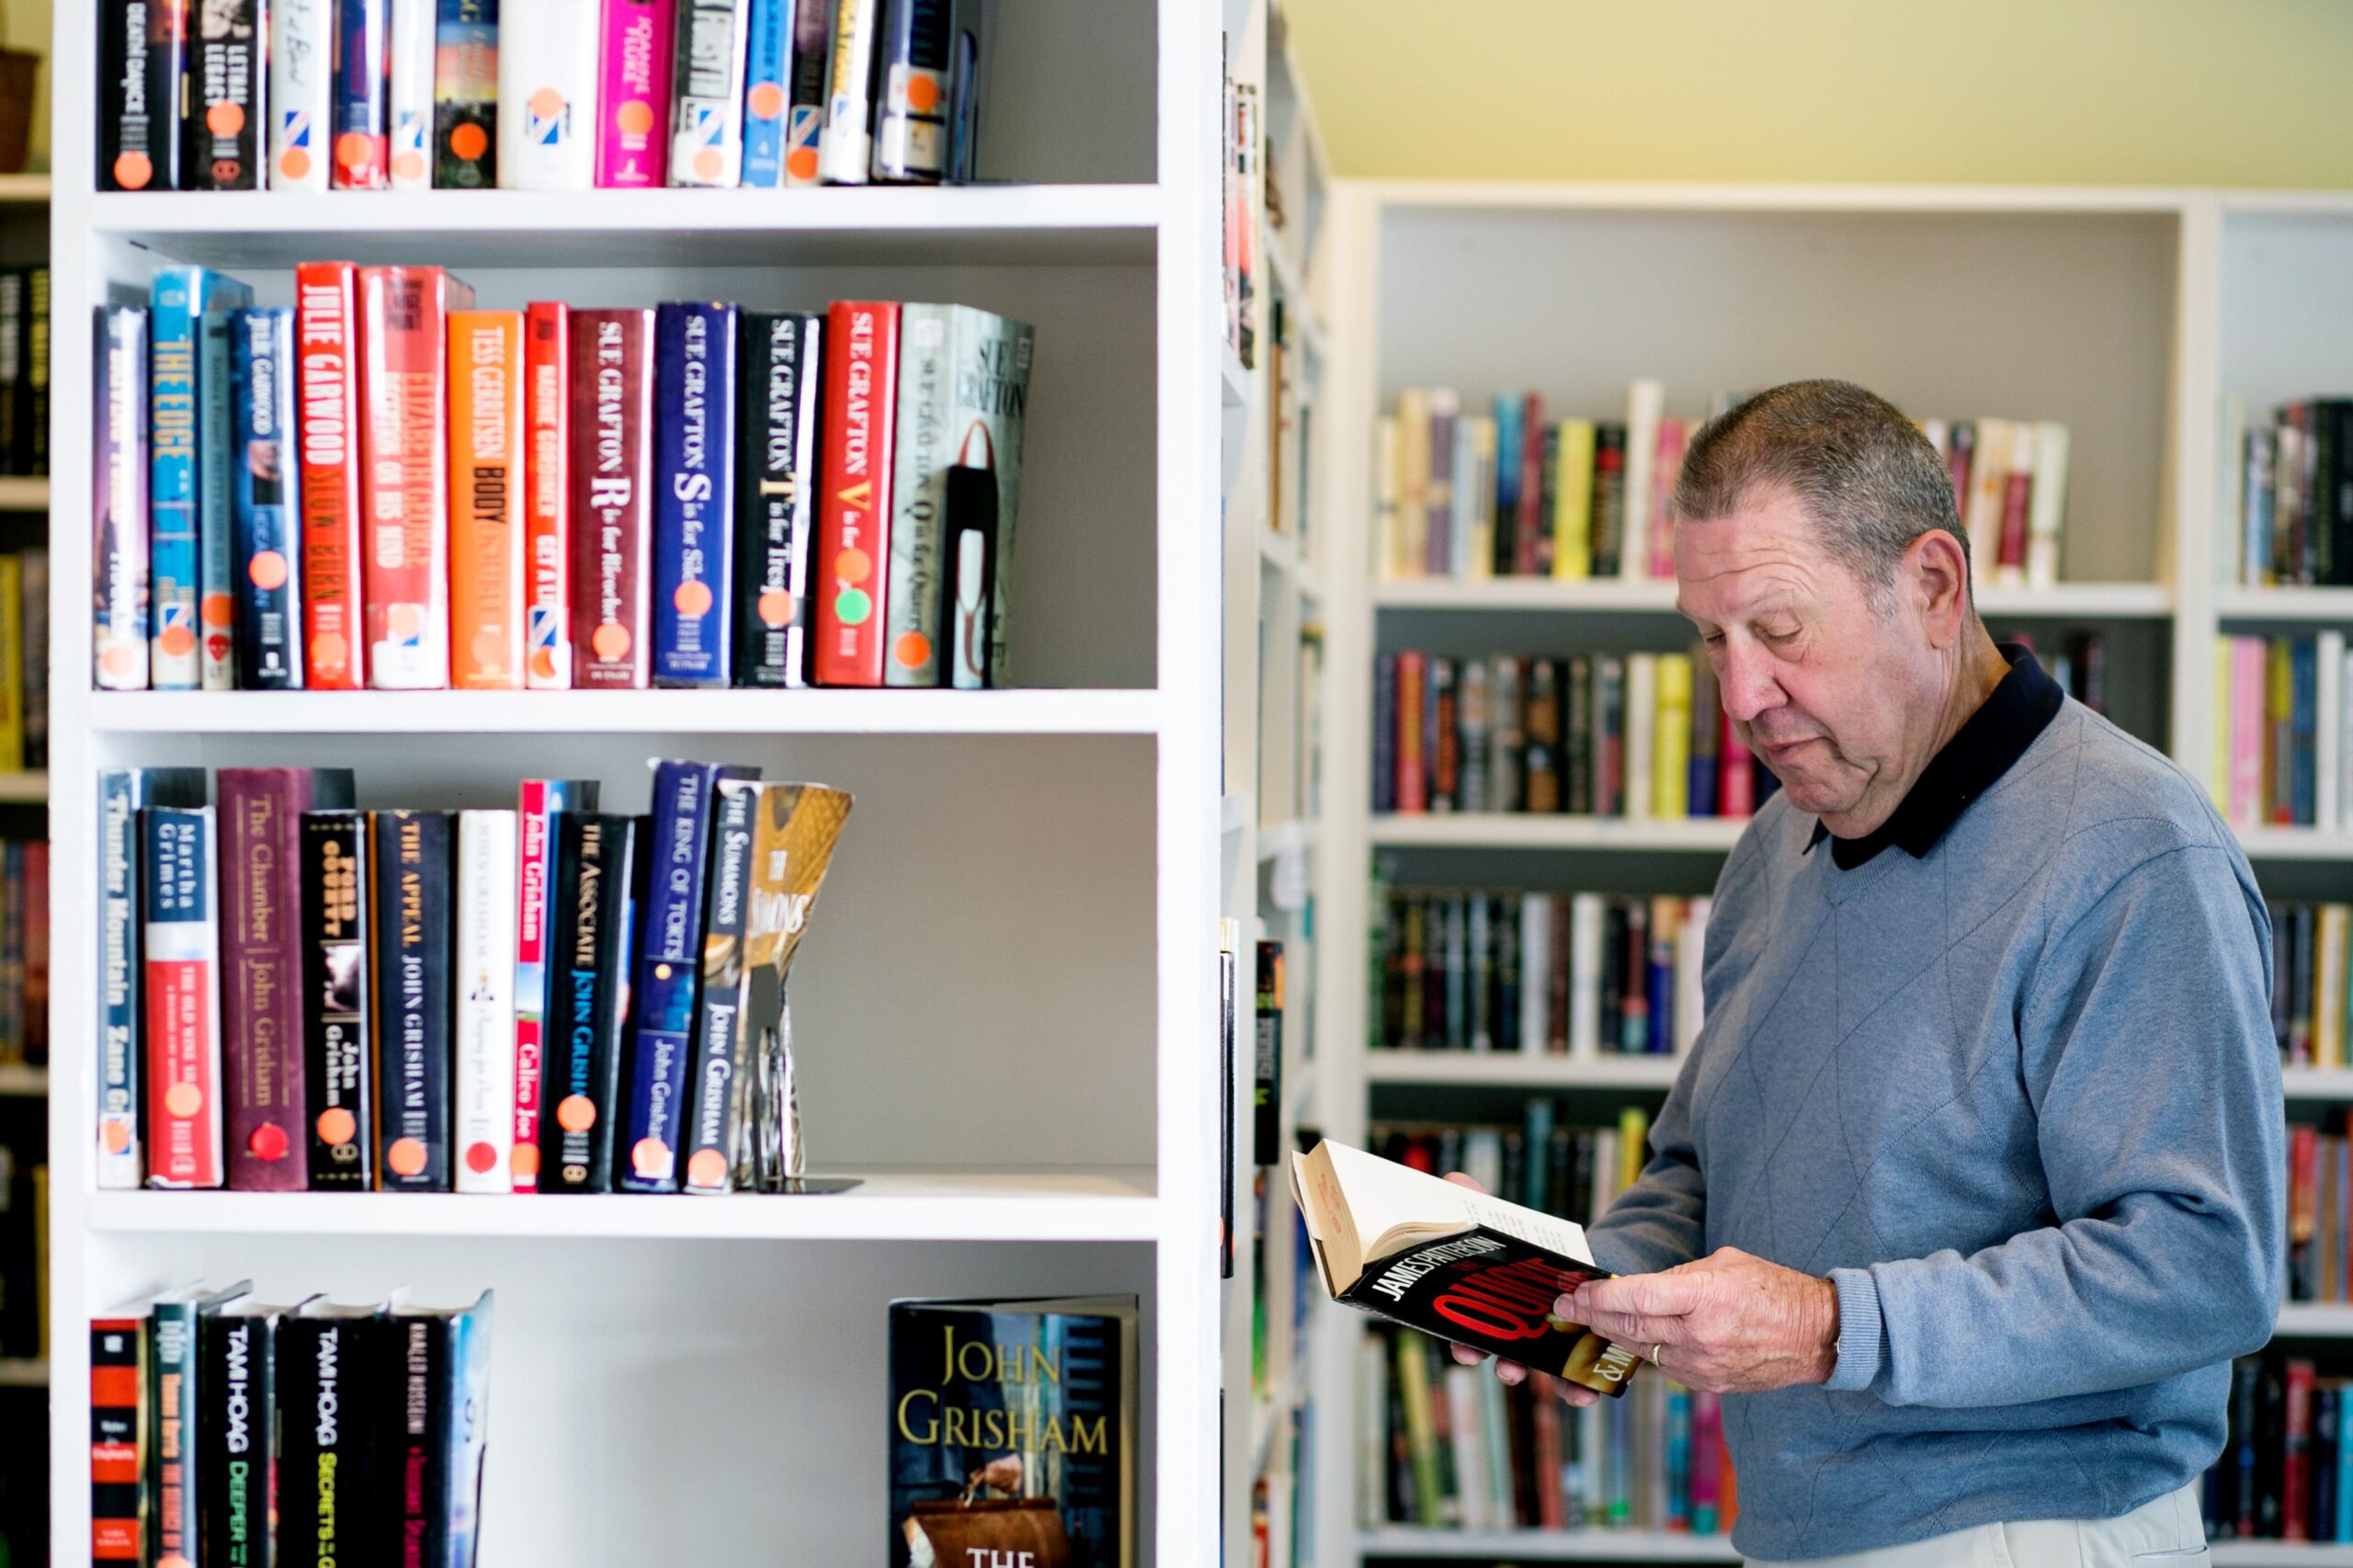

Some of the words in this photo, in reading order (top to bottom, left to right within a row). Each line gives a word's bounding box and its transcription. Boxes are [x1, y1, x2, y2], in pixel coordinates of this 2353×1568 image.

[634, 16, 652, 95] JOANNE
[247, 316, 272, 357] JULIE
[303, 286, 344, 346] JULIE
[685, 315, 706, 359] SUE
[771, 320, 796, 363] SUE
[850, 312, 872, 358] SUE
[153, 338, 193, 387] THE
[472, 326, 505, 364] TESS
[598, 322, 623, 365] SUE
[252, 358, 273, 436] GARWOOD
[304, 354, 346, 465] GARWOOD
[472, 367, 505, 459] GERRITSEN
[535, 364, 557, 427] NADINE
[598, 369, 624, 472] GRAFTON
[684, 361, 706, 469] GRAFTON
[769, 364, 795, 471] GRAFTON
[845, 360, 872, 474] GRAFTON
[153, 393, 193, 461] EDGE
[404, 371, 435, 478] ELIZABETH
[307, 471, 344, 528] SLOW
[375, 461, 404, 485] ON
[473, 466, 506, 526] BODY
[535, 430, 557, 517] GORDIMER
[592, 476, 632, 509] R
[675, 472, 711, 501] S
[760, 472, 798, 505] T
[837, 480, 871, 511] V
[375, 490, 404, 519] HIS
[403, 487, 434, 569] GEORGE
[603, 509, 621, 525] is
[683, 502, 703, 518] is
[768, 518, 791, 542] for
[769, 503, 788, 517] is
[843, 512, 859, 526] is
[904, 501, 934, 522] Q
[375, 526, 404, 569] MIND
[536, 535, 557, 566] GET
[602, 526, 625, 552] for
[682, 519, 704, 547] for
[842, 526, 860, 549] for
[308, 543, 345, 600] BURN
[536, 569, 557, 583] A
[602, 553, 625, 624] Ricochet
[249, 795, 272, 836] The
[679, 775, 699, 813] THE
[726, 792, 747, 826] THE
[107, 794, 130, 892] Thunder
[402, 822, 421, 863] THE
[477, 824, 489, 869] JOHN
[524, 812, 543, 858] John
[582, 824, 601, 858] THE
[673, 818, 695, 864] KING
[159, 823, 178, 908] Grimes
[178, 824, 197, 909] Martha
[324, 839, 341, 937] COUNTY
[340, 856, 357, 922] FORD
[671, 870, 691, 895] OF
[718, 830, 750, 926] SUMMONS
[251, 844, 276, 943] Chamber
[402, 870, 421, 949] APPEAL
[523, 860, 543, 941] Grisham
[575, 861, 601, 966] ASSOCIATE
[107, 898, 130, 1005] Mountain
[665, 900, 688, 960] TORTS
[180, 966, 196, 991] THE
[246, 960, 276, 1011] John
[402, 954, 424, 1008] JOHN
[571, 970, 597, 1022] JOHN
[181, 994, 196, 1023] OLD
[709, 1003, 735, 1055] JOHN
[108, 1025, 130, 1085] Zane
[182, 1026, 197, 1060] WINE
[254, 1018, 279, 1107] Grisham
[325, 1024, 344, 1107] Grisham
[342, 1042, 358, 1089] John
[404, 1013, 425, 1108] GRISHAM
[652, 1039, 675, 1082] John
[517, 1044, 536, 1104] Calico
[701, 1057, 732, 1144] GRISHAM
[515, 1107, 534, 1138] Joe
[1372, 1257, 1435, 1302] JAMES
[1412, 1236, 1507, 1267] PATTERSON
[226, 1325, 248, 1381] TAMI
[316, 1327, 337, 1378] TAMI
[407, 1323, 427, 1373] KHALED
[941, 1324, 1062, 1386] JOHN
[226, 1382, 249, 1453] HOAG
[316, 1380, 337, 1447] HOAG
[407, 1375, 427, 1435] HOSSEINI
[897, 1389, 1108, 1456] GRISHAM
[229, 1461, 249, 1542] DEEPER
[318, 1452, 337, 1540] SECRETS
[967, 1548, 1035, 1568] THE
